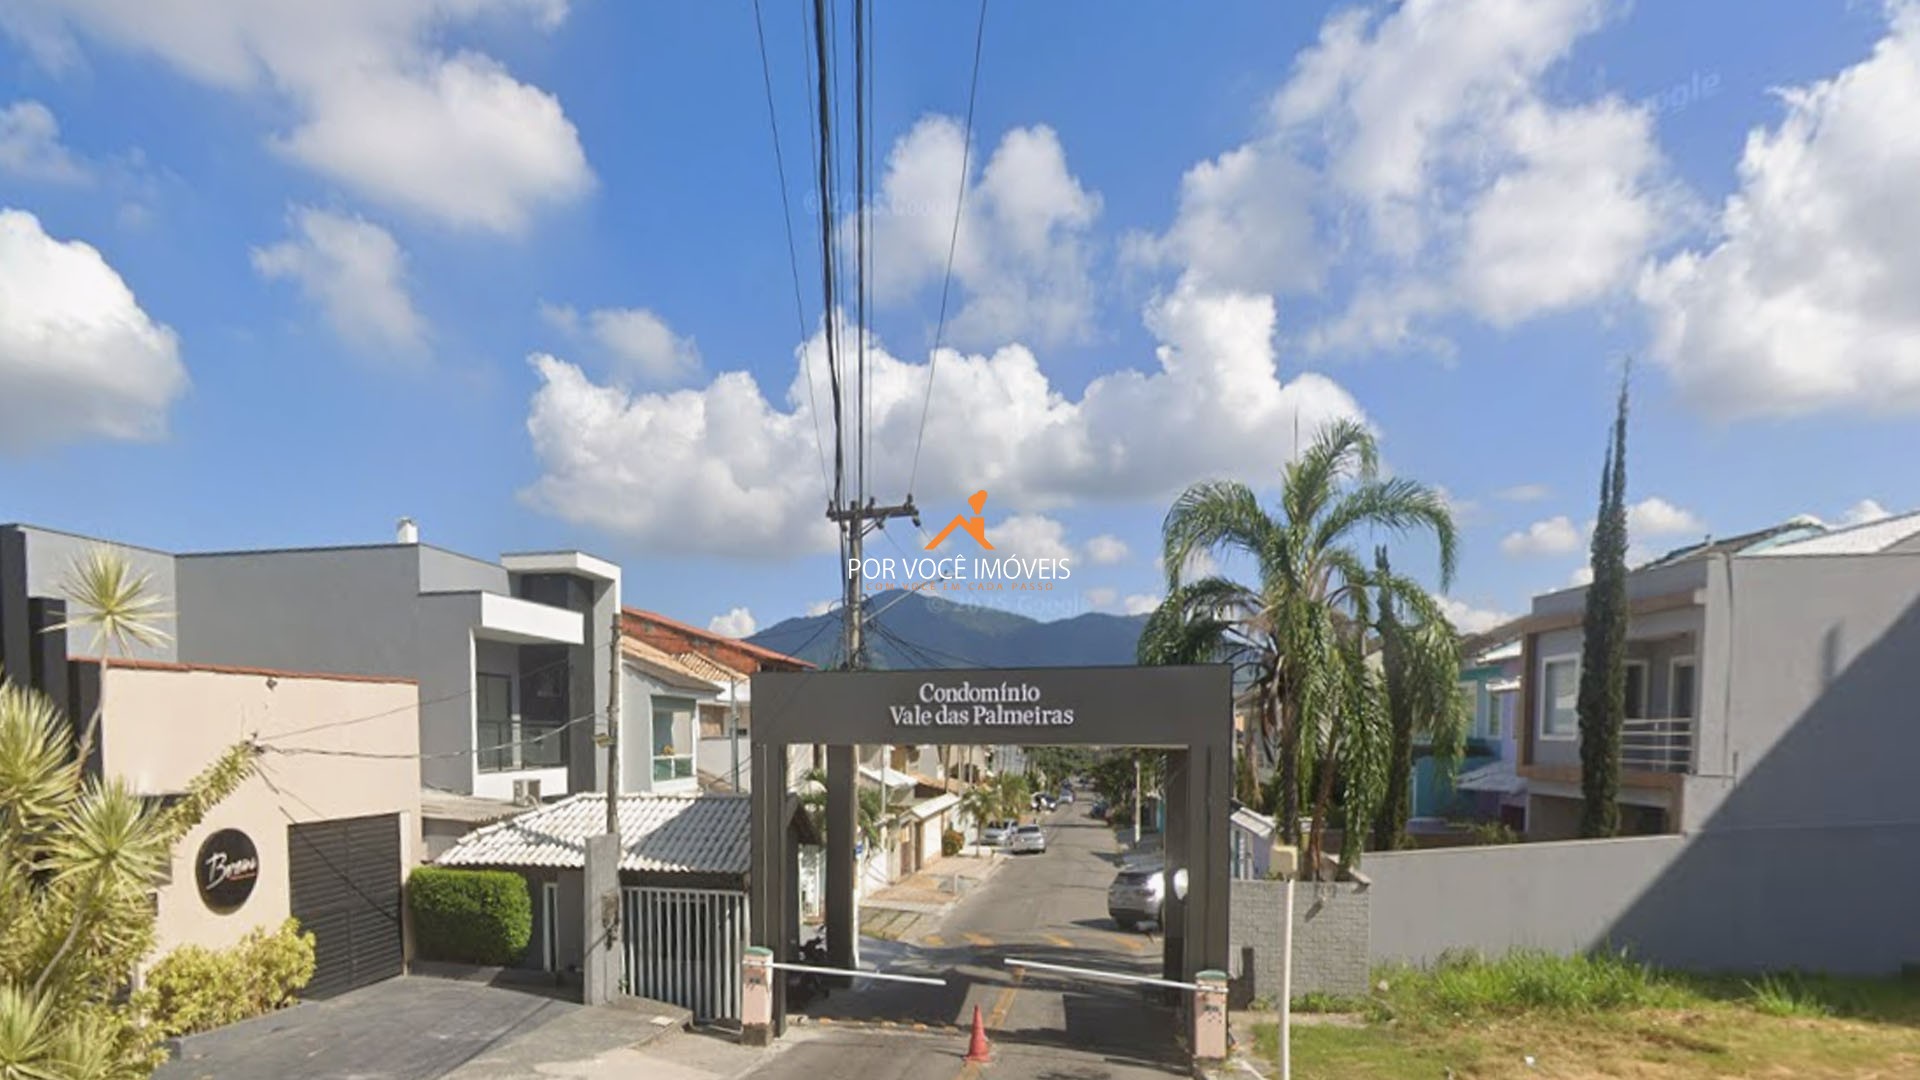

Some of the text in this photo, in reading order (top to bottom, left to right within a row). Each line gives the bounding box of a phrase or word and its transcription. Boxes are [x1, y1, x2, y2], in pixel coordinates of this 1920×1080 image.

[919, 681, 1041, 703] Condomínio
[889, 703, 1075, 726] Vale das Palmeiras
